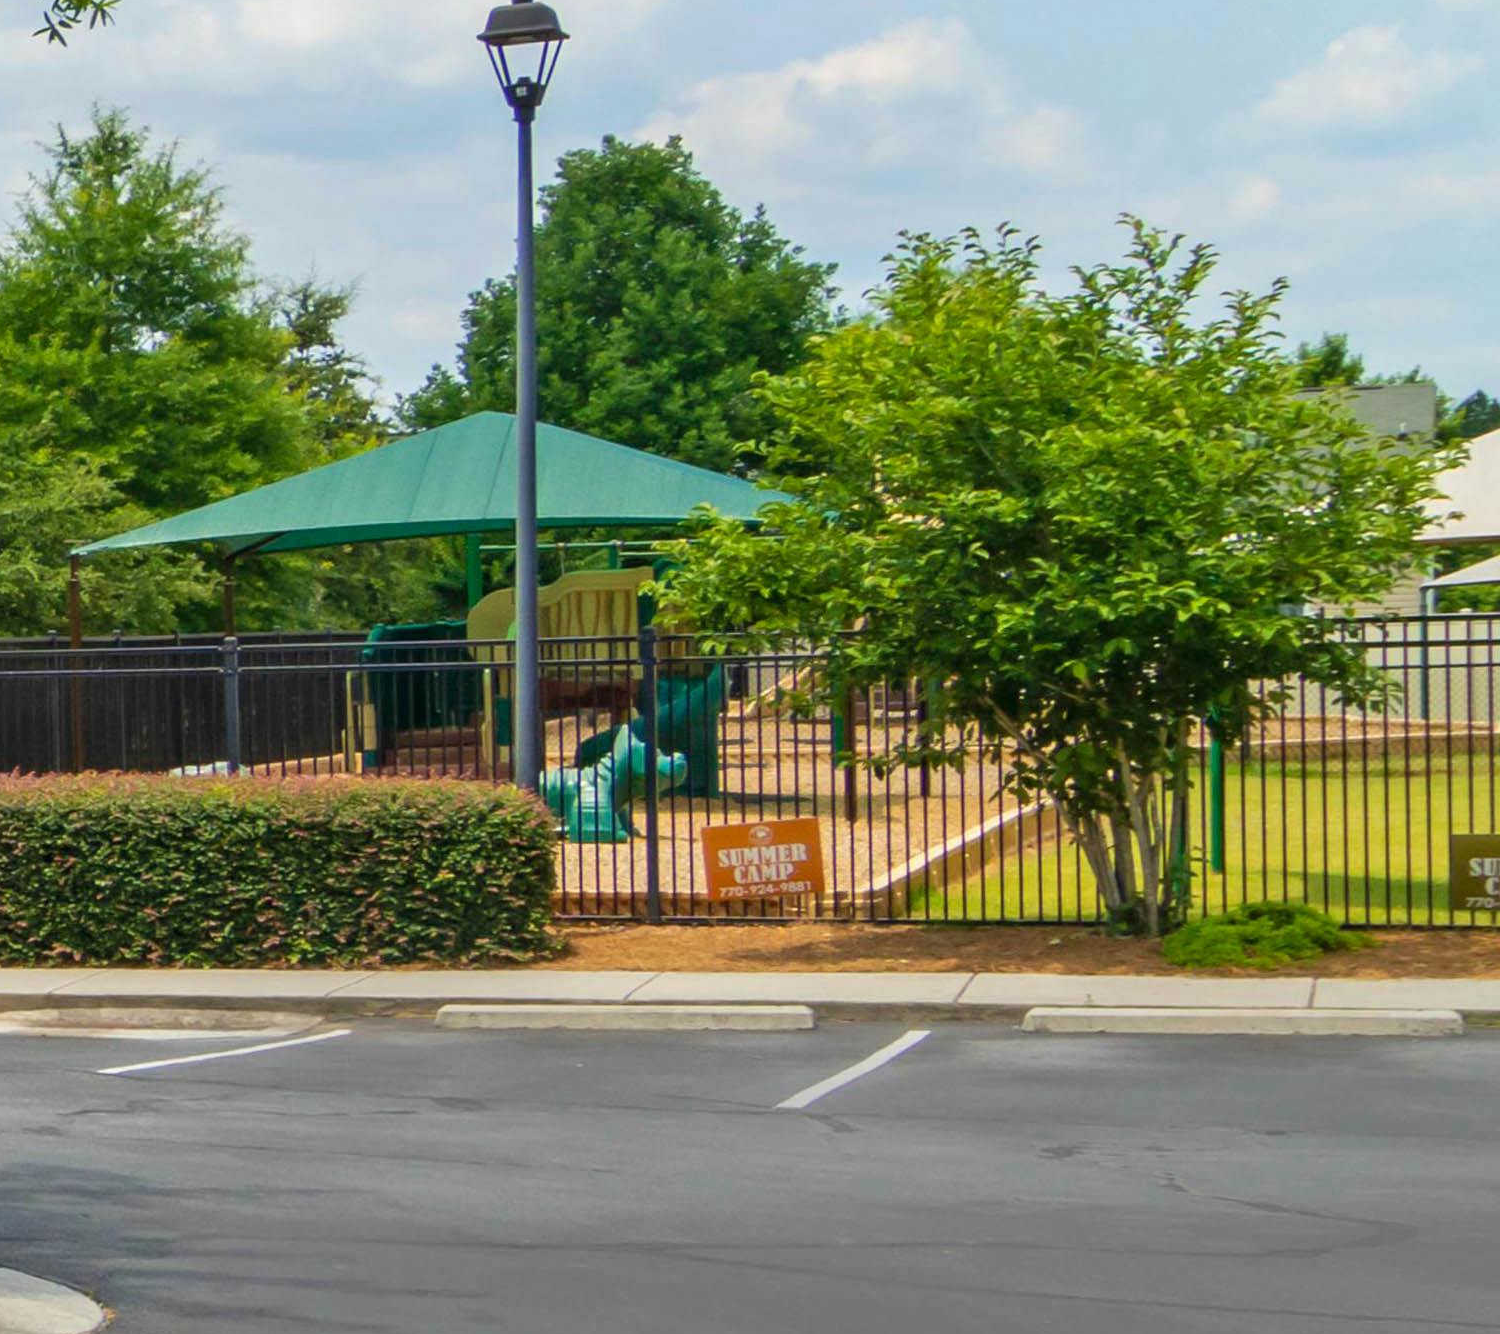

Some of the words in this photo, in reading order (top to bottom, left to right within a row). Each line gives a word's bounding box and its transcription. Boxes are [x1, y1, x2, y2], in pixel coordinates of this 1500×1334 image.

[717, 842, 808, 867] SUMMER
[733, 862, 795, 885] CAMP
[719, 880, 812, 898] 770-924-9881
